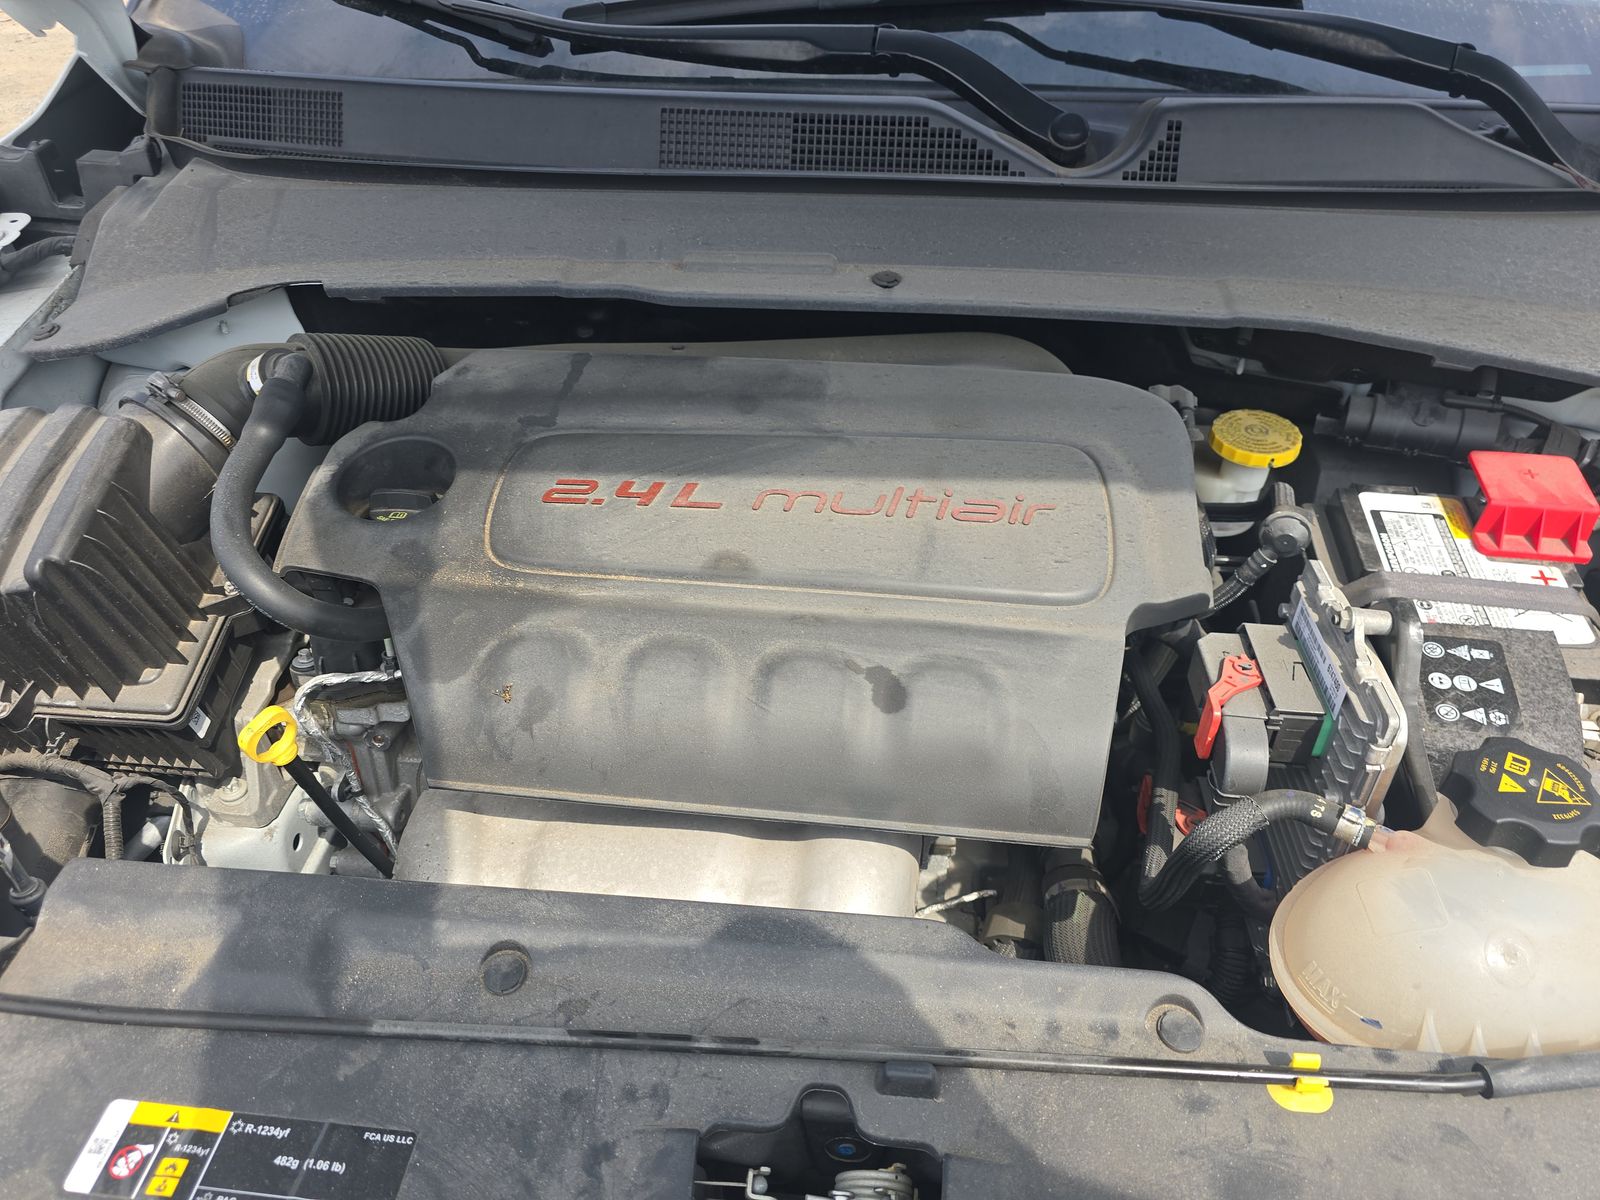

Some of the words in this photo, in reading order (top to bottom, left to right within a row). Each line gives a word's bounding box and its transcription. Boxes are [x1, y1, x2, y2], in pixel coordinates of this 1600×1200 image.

[752, 486, 1057, 526] multiair
[1302, 960, 1345, 1009] MAX
[244, 1123, 291, 1139] R-1234yf
[363, 1131, 381, 1141] FCA
[382, 1133, 395, 1142] US
[396, 1135, 414, 1145] LLC
[174, 1143, 211, 1157] R-1234yf
[273, 1155, 300, 1170] 482g
[303, 1158, 330, 1171] (1.06
[331, 1161, 346, 1175] lb)
